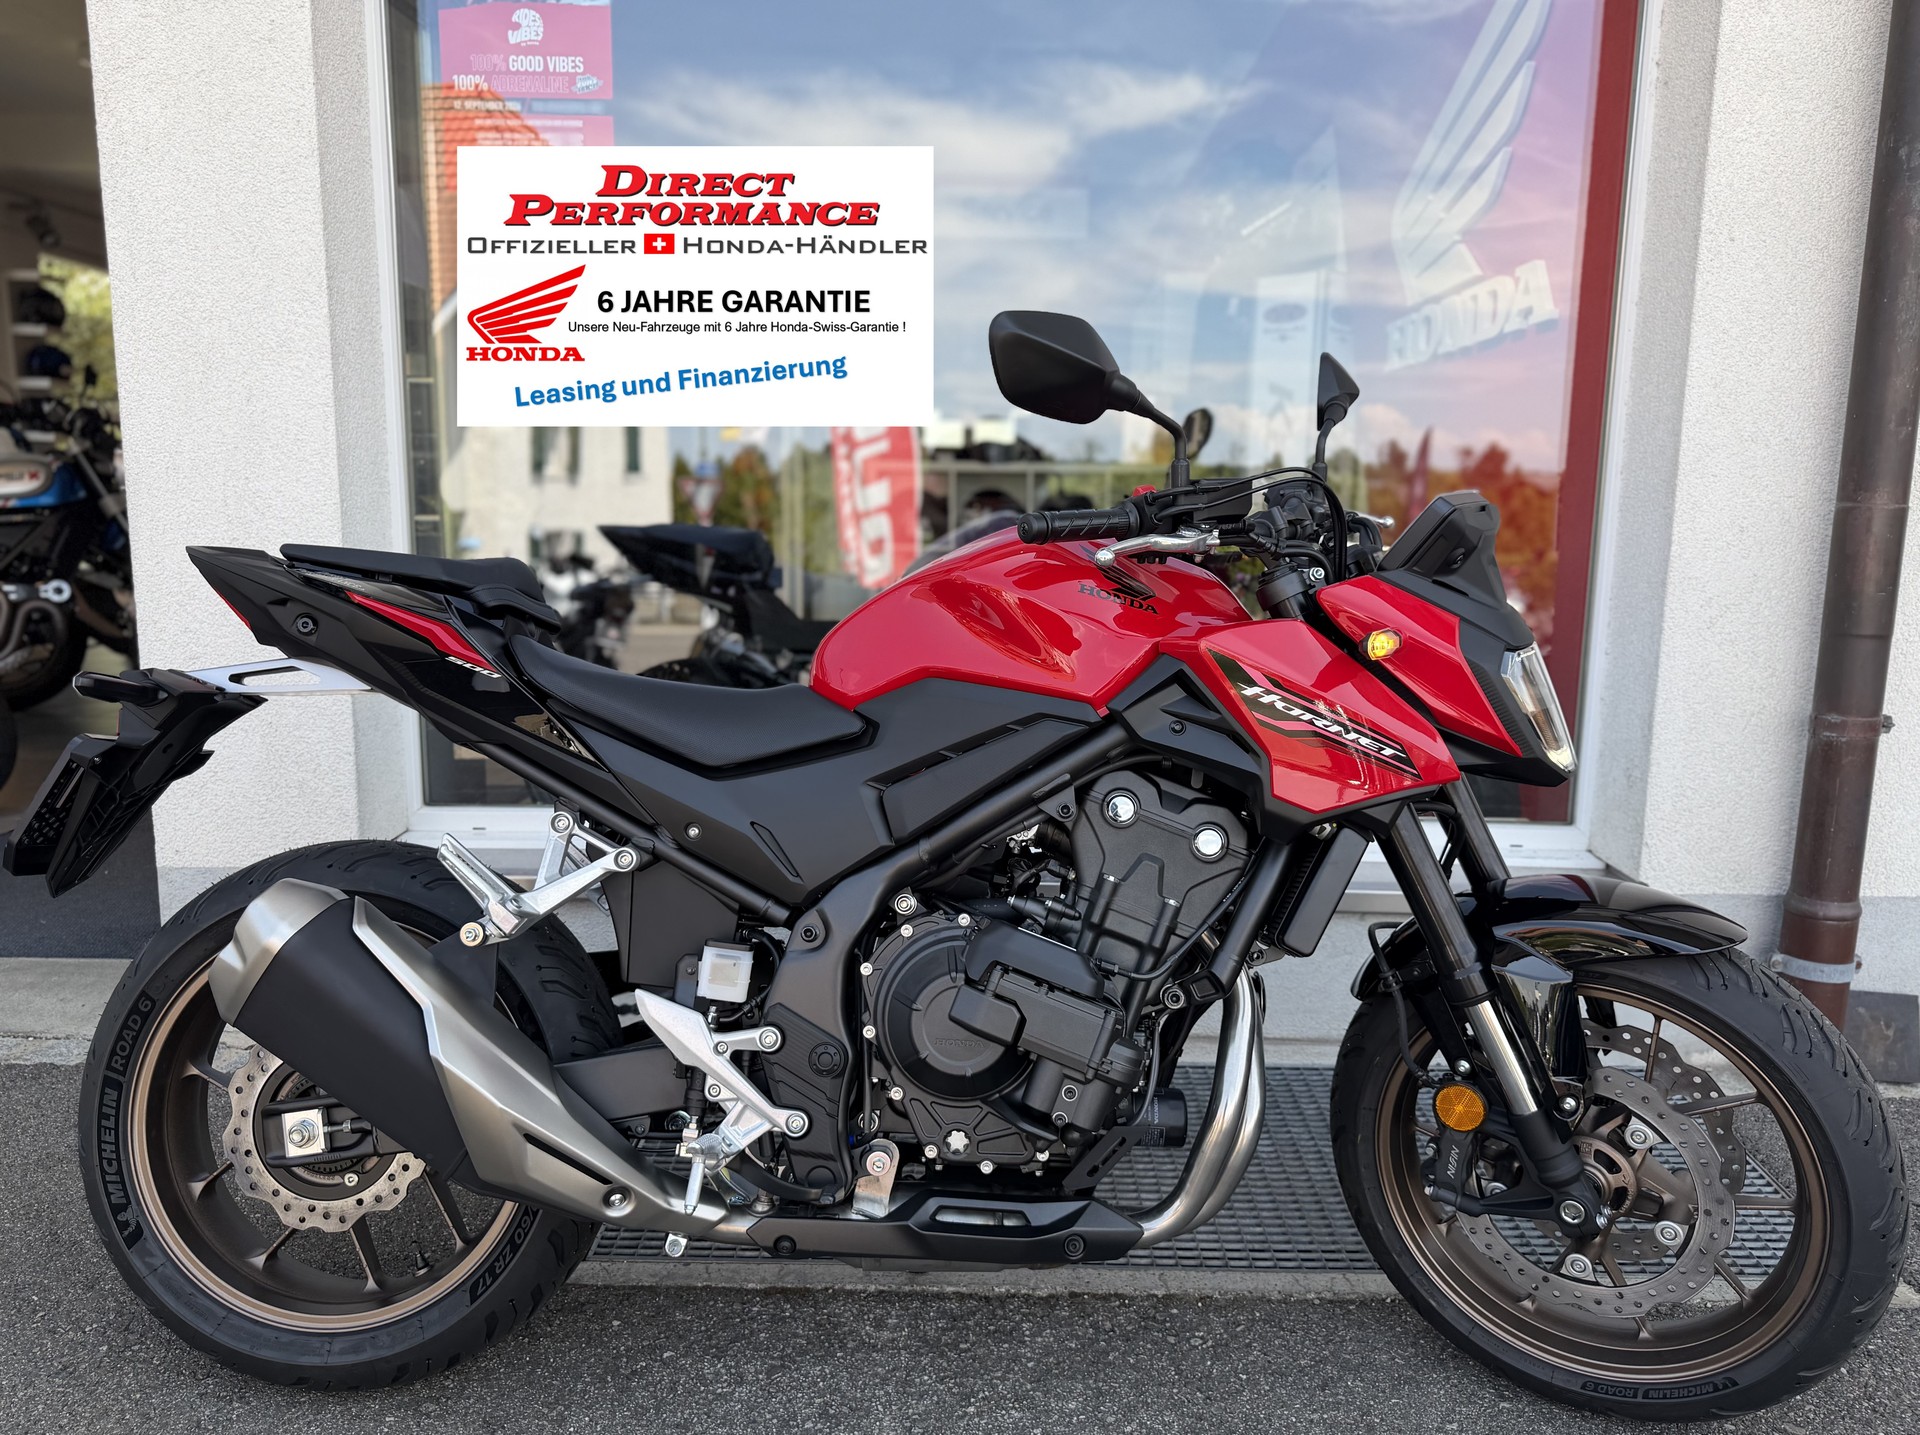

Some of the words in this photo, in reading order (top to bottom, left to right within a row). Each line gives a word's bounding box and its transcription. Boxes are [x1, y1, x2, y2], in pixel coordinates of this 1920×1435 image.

[508, 26, 544, 44] VIBES
[470, 54, 506, 71] 100%
[509, 55, 543, 72] GOOD
[547, 56, 584, 73] VIBES
[452, 74, 488, 91] 100%
[491, 75, 569, 94] ADRENALINE
[1384, 259, 1560, 373] HONDA
[1078, 581, 1158, 614] HONDA
[445, 656, 502, 678] 500
[1237, 682, 1406, 757] HORNET
[138, 998, 152, 1012] 6
[111, 1014, 142, 1072] ROAD
[934, 1037, 985, 1049] HONDA
[101, 1087, 127, 1204] MICHELIN
[1446, 1144, 1460, 1179] NISSIN
[515, 1204, 539, 1244] /60
[495, 1243, 514, 1275] ZR
[477, 1272, 493, 1296] 17
[1585, 1382, 1594, 1391] 6
[1598, 1384, 1635, 1398] ROAD
[1648, 1383, 1714, 1399] MICHELIN
